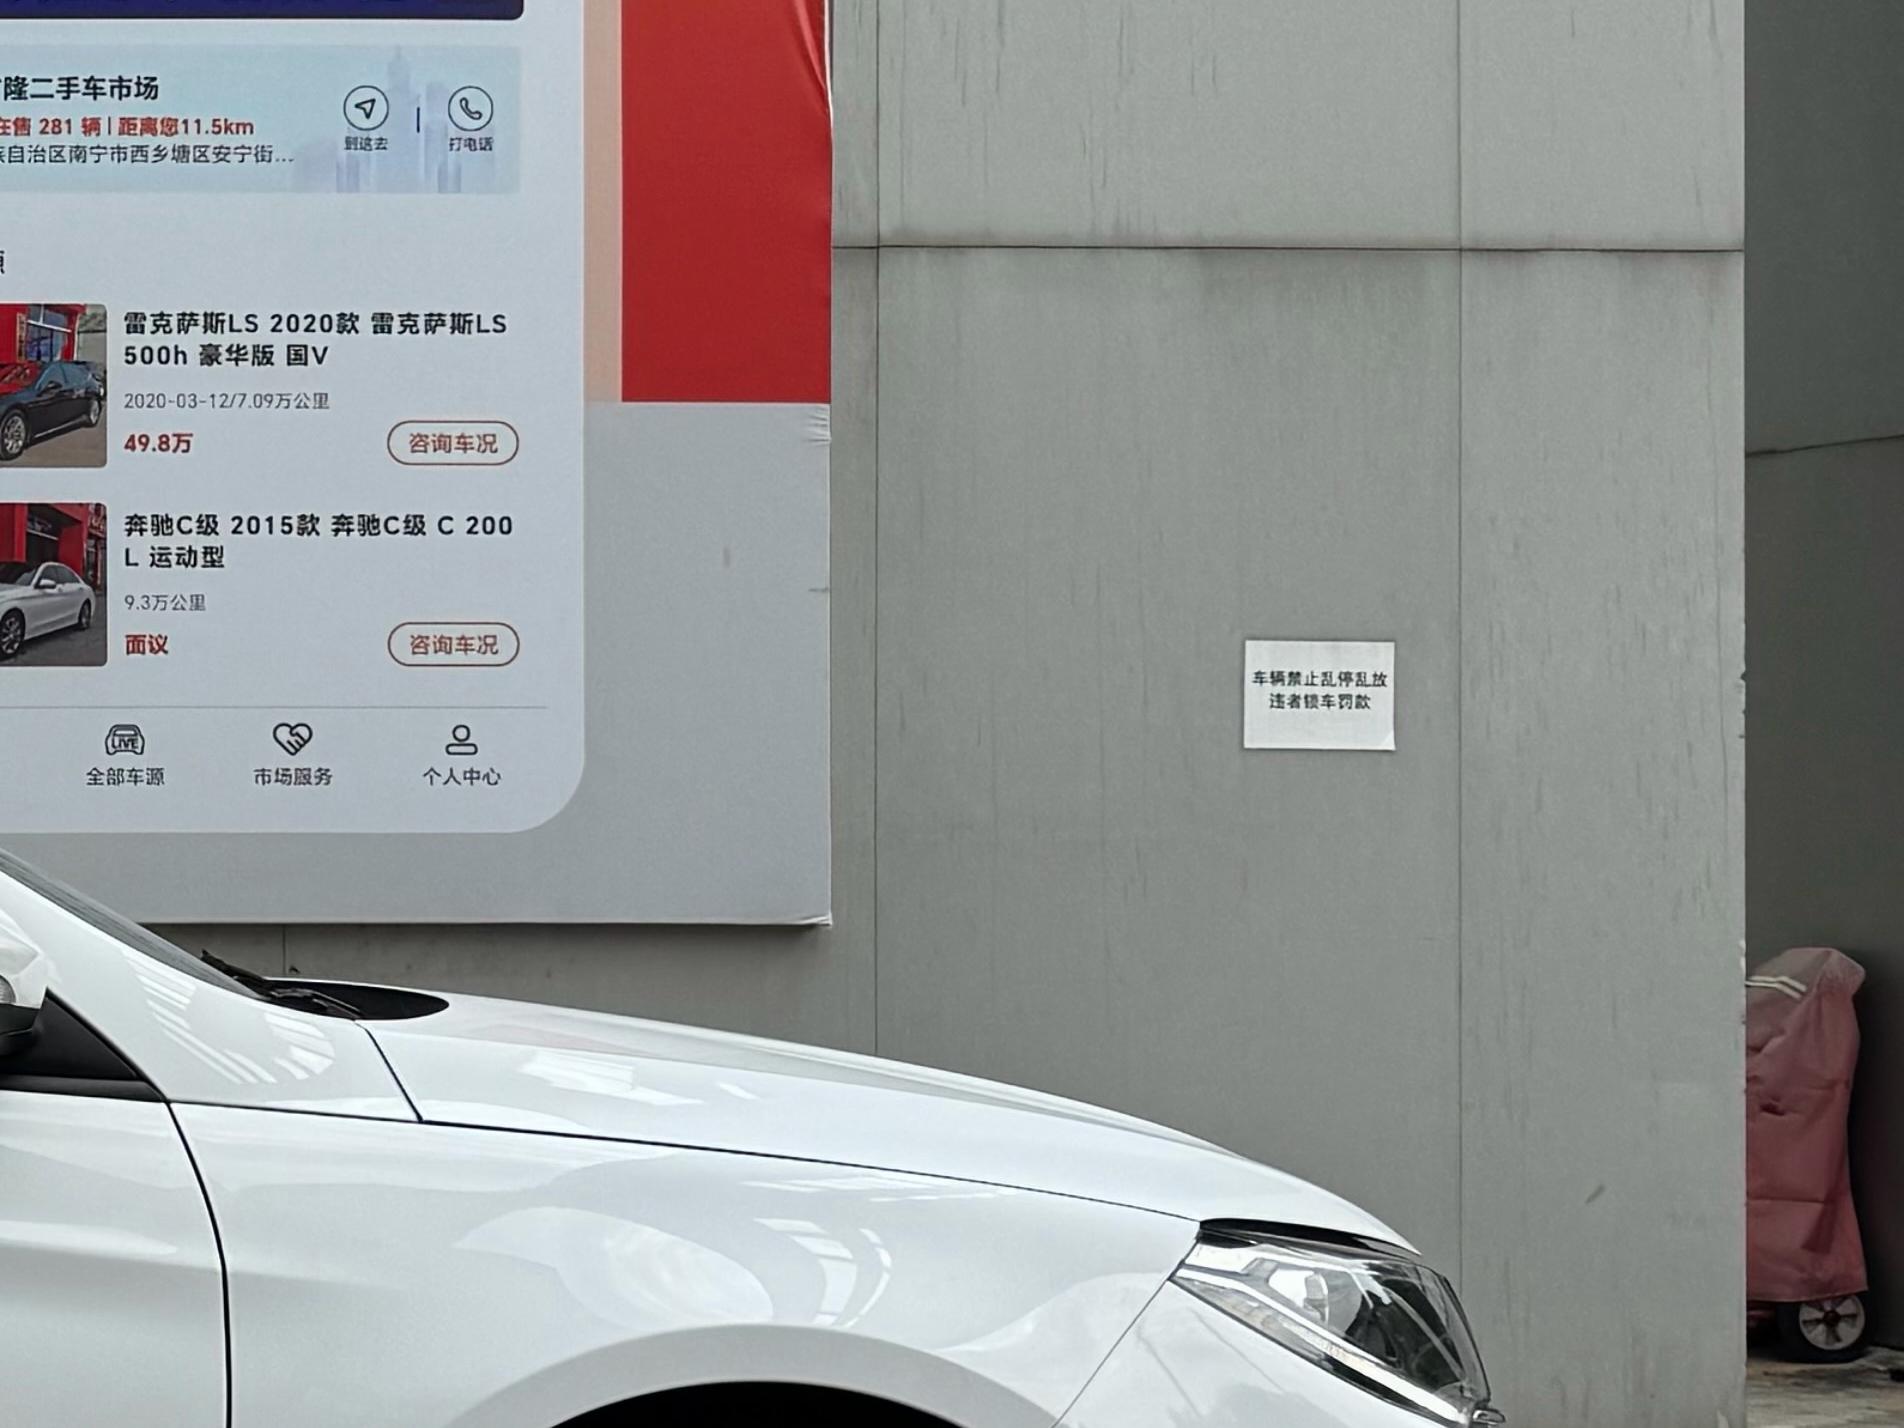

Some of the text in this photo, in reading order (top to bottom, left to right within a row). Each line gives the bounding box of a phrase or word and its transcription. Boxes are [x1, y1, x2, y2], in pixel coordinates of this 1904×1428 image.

[39, 118, 71, 135] 281
[82, 117, 101, 136] 辆
[118, 117, 253, 137] 距离您11.5km
[449, 137, 493, 151] 打电话
[124, 311, 506, 334] 雷克萨斯LS 2020款 雷克萨斯LS
[125, 343, 328, 366] 500h 豪华版 国V
[125, 393, 329, 409] 2020-03-12/7.09万公里
[124, 434, 193, 453] 49.8万
[410, 433, 498, 453] 咨询车况
[125, 514, 512, 537] 奔驰C级 2015款 奔驰C级 C 200
[126, 545, 224, 568] L 运动型
[125, 594, 205, 611] 9.3万公里
[126, 634, 168, 655] 面议
[411, 635, 498, 655] 咨询车况
[1253, 671, 1387, 687] 车辆禁止乱停乱放
[87, 768, 164, 786] 全部车源
[254, 768, 332, 785] 市场服务
[423, 768, 501, 785] 个人中心
